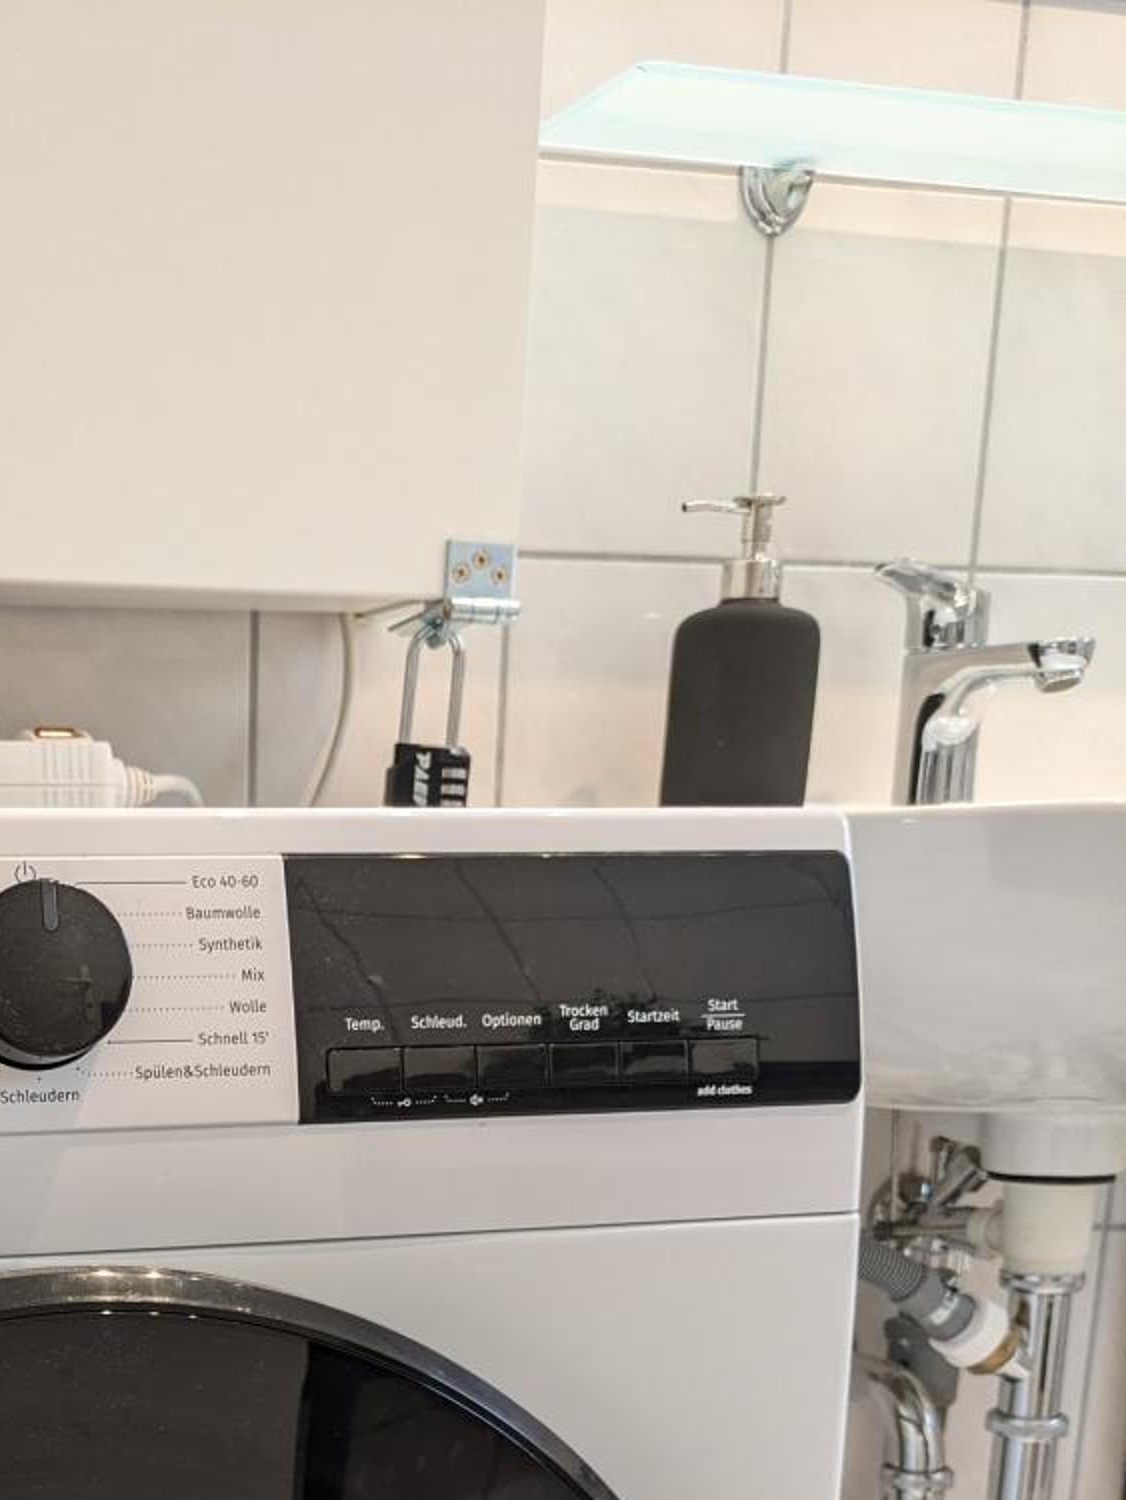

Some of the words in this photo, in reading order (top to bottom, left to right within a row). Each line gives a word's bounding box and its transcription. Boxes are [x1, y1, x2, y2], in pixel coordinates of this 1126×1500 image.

[192, 875, 217, 888] Eco
[219, 875, 259, 888] 40-60
[185, 906, 261, 920] Baumwolle
[199, 937, 263, 953] Synthetik
[241, 968, 265, 981] Mix
[229, 1001, 267, 1013] Wolle
[559, 1004, 609, 1017] Trocken
[707, 999, 738, 1012] Start
[410, 1013, 467, 1029] Schleud.
[481, 1011, 542, 1029] Optionen
[627, 1008, 680, 1023] Startzeit
[345, 1017, 385, 1033] Temp.
[569, 1018, 599, 1031] Grad
[707, 1018, 743, 1031] Pause
[198, 1032, 248, 1045] Schnell
[252, 1031, 269, 1044] 15'
[135, 1063, 271, 1080] Spülen&Schleudern
[0, 1090, 80, 1104] Schleudern
